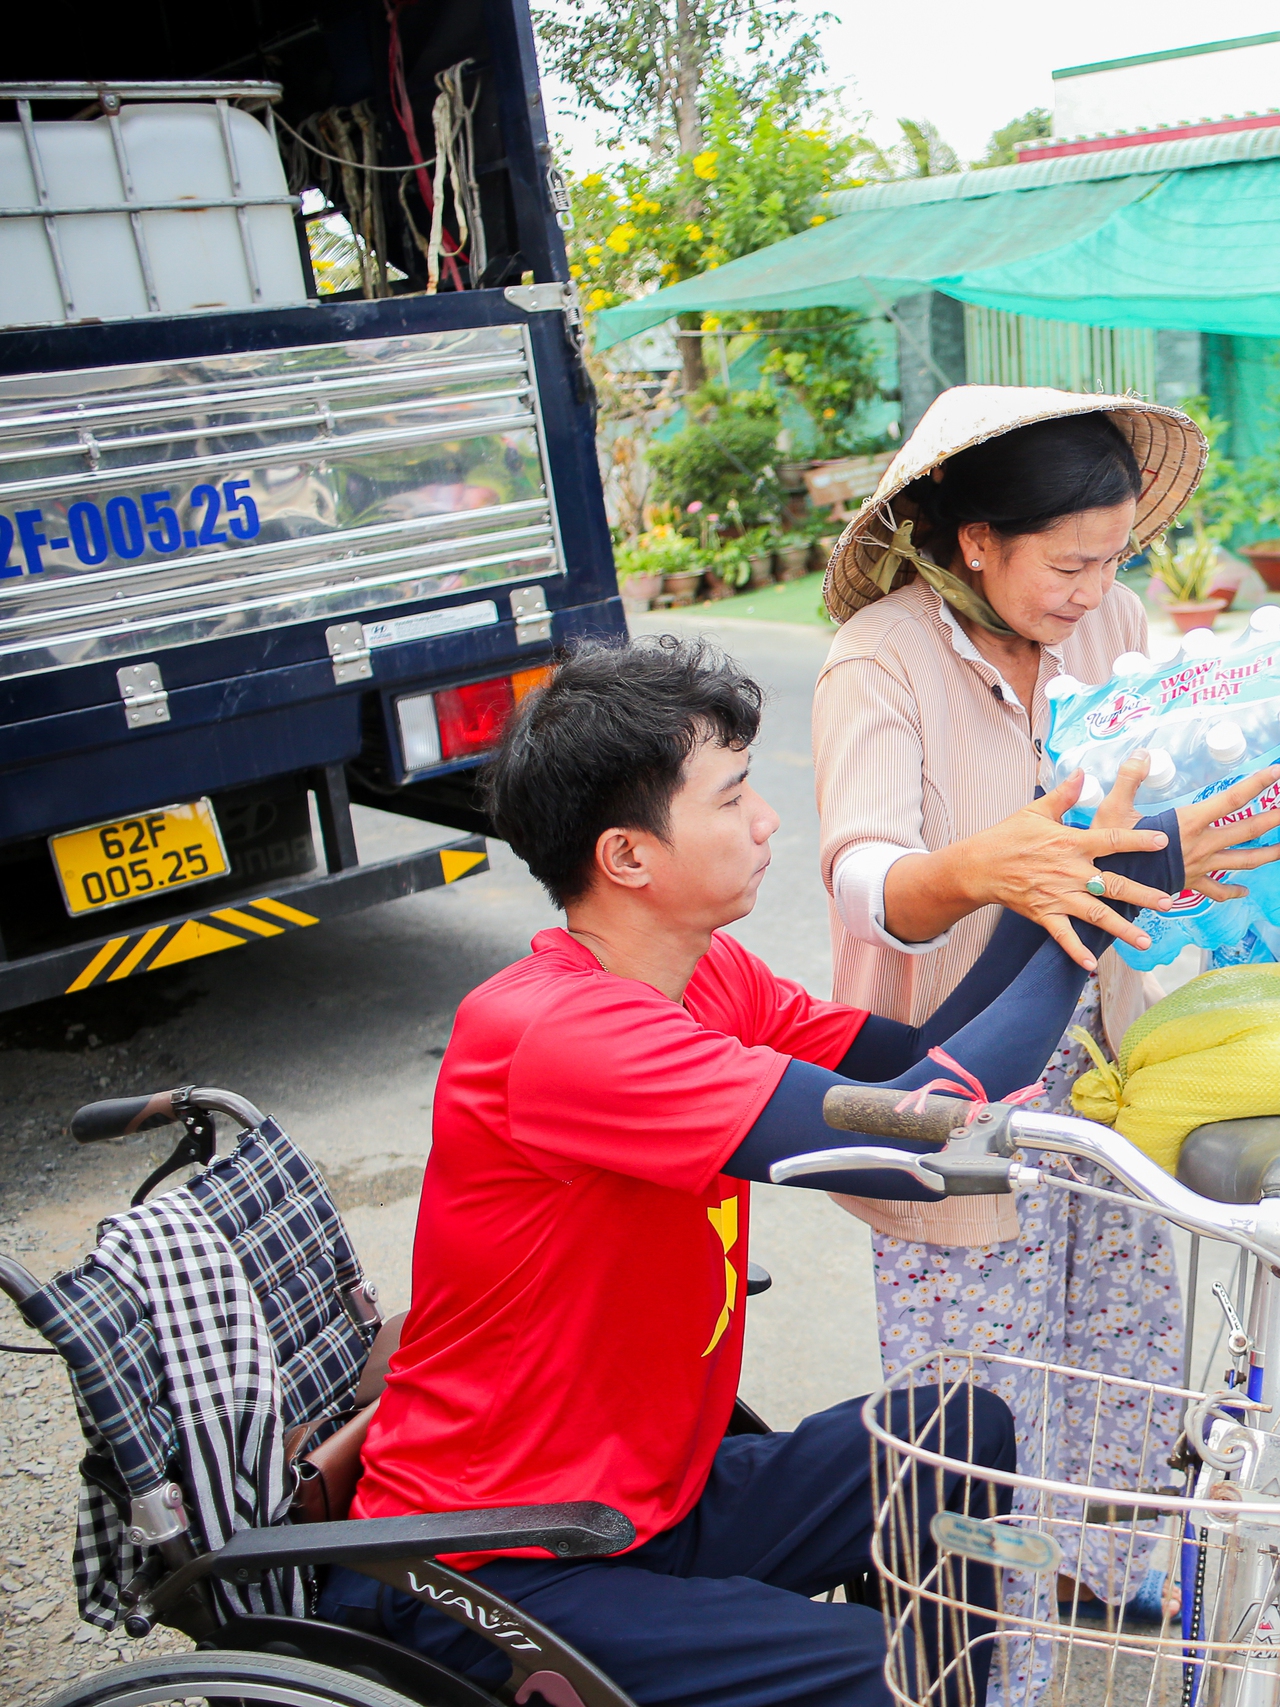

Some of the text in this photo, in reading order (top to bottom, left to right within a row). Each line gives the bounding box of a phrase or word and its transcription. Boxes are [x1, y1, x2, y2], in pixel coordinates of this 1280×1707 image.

[1160, 660, 1221, 690] WOW!
[1160, 675, 1205, 704] TINH
[1190, 681, 1243, 705] THẬT
[1213, 807, 1253, 828] INH
[99, 814, 166, 859] 62F
[82, 843, 208, 904] 005.25
